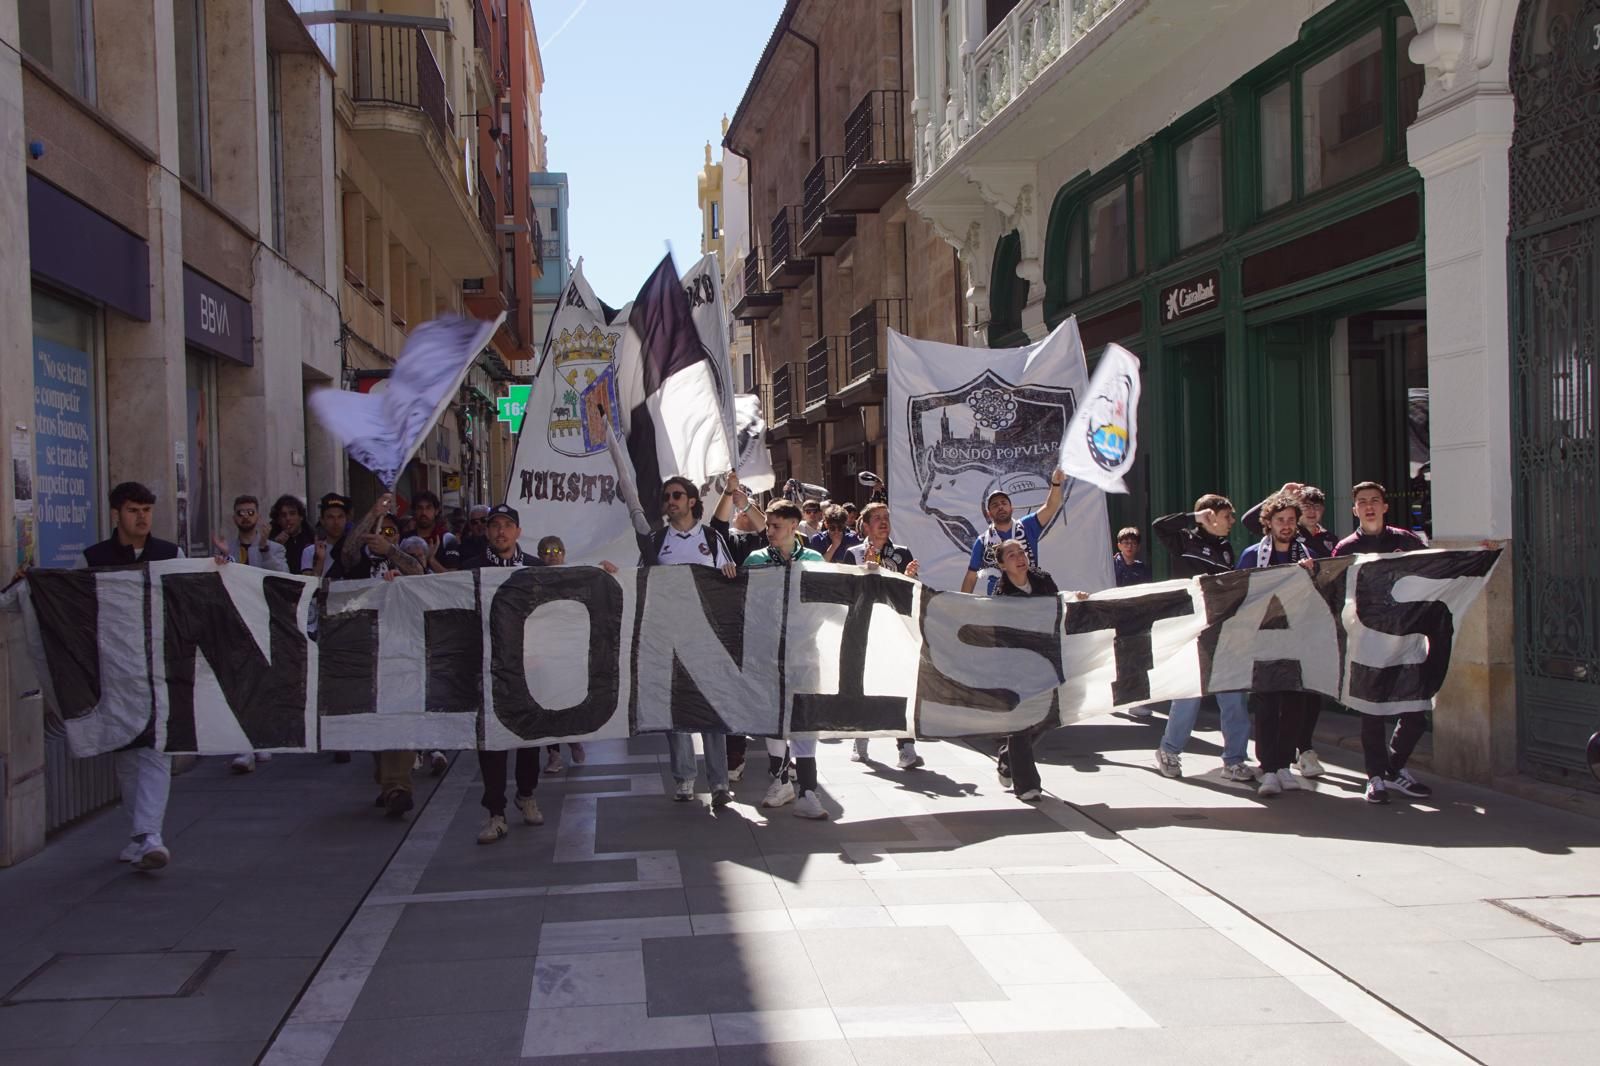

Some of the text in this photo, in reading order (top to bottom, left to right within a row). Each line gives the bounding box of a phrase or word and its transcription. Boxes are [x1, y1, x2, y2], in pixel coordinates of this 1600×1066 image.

[201, 293, 230, 336] BBVA
[57, 362, 67, 382] se
[67, 362, 87, 387] trata
[41, 386, 80, 415] competir
[57, 413, 89, 444] bancos,
[46, 445, 88, 469] se trata de
[941, 447, 991, 460] FONDO
[69, 478, 85, 496] con
[44, 497, 54, 522] lo
[55, 504, 71, 528] que
[20, 549, 1503, 758] UNIONISTAS
